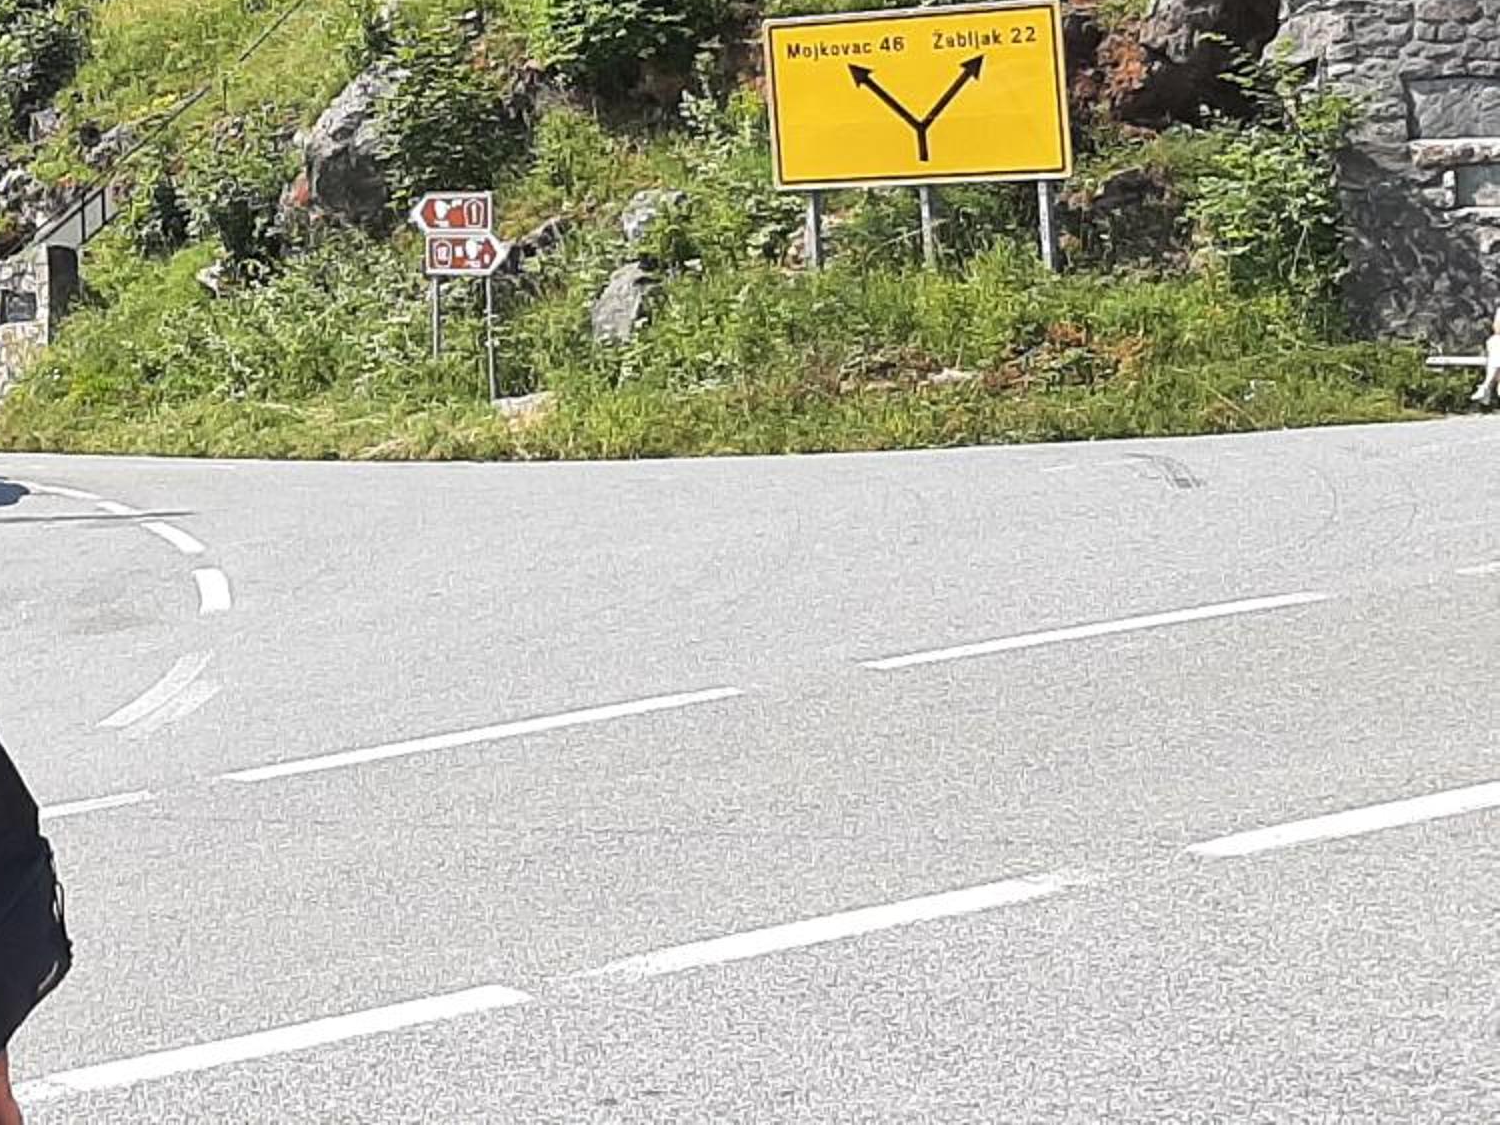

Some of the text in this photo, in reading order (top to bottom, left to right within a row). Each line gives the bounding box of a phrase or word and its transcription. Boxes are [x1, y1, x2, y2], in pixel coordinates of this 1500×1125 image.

[787, 36, 905, 60] Mojkovac 46
[932, 26, 1036, 50] Žabljak 22
